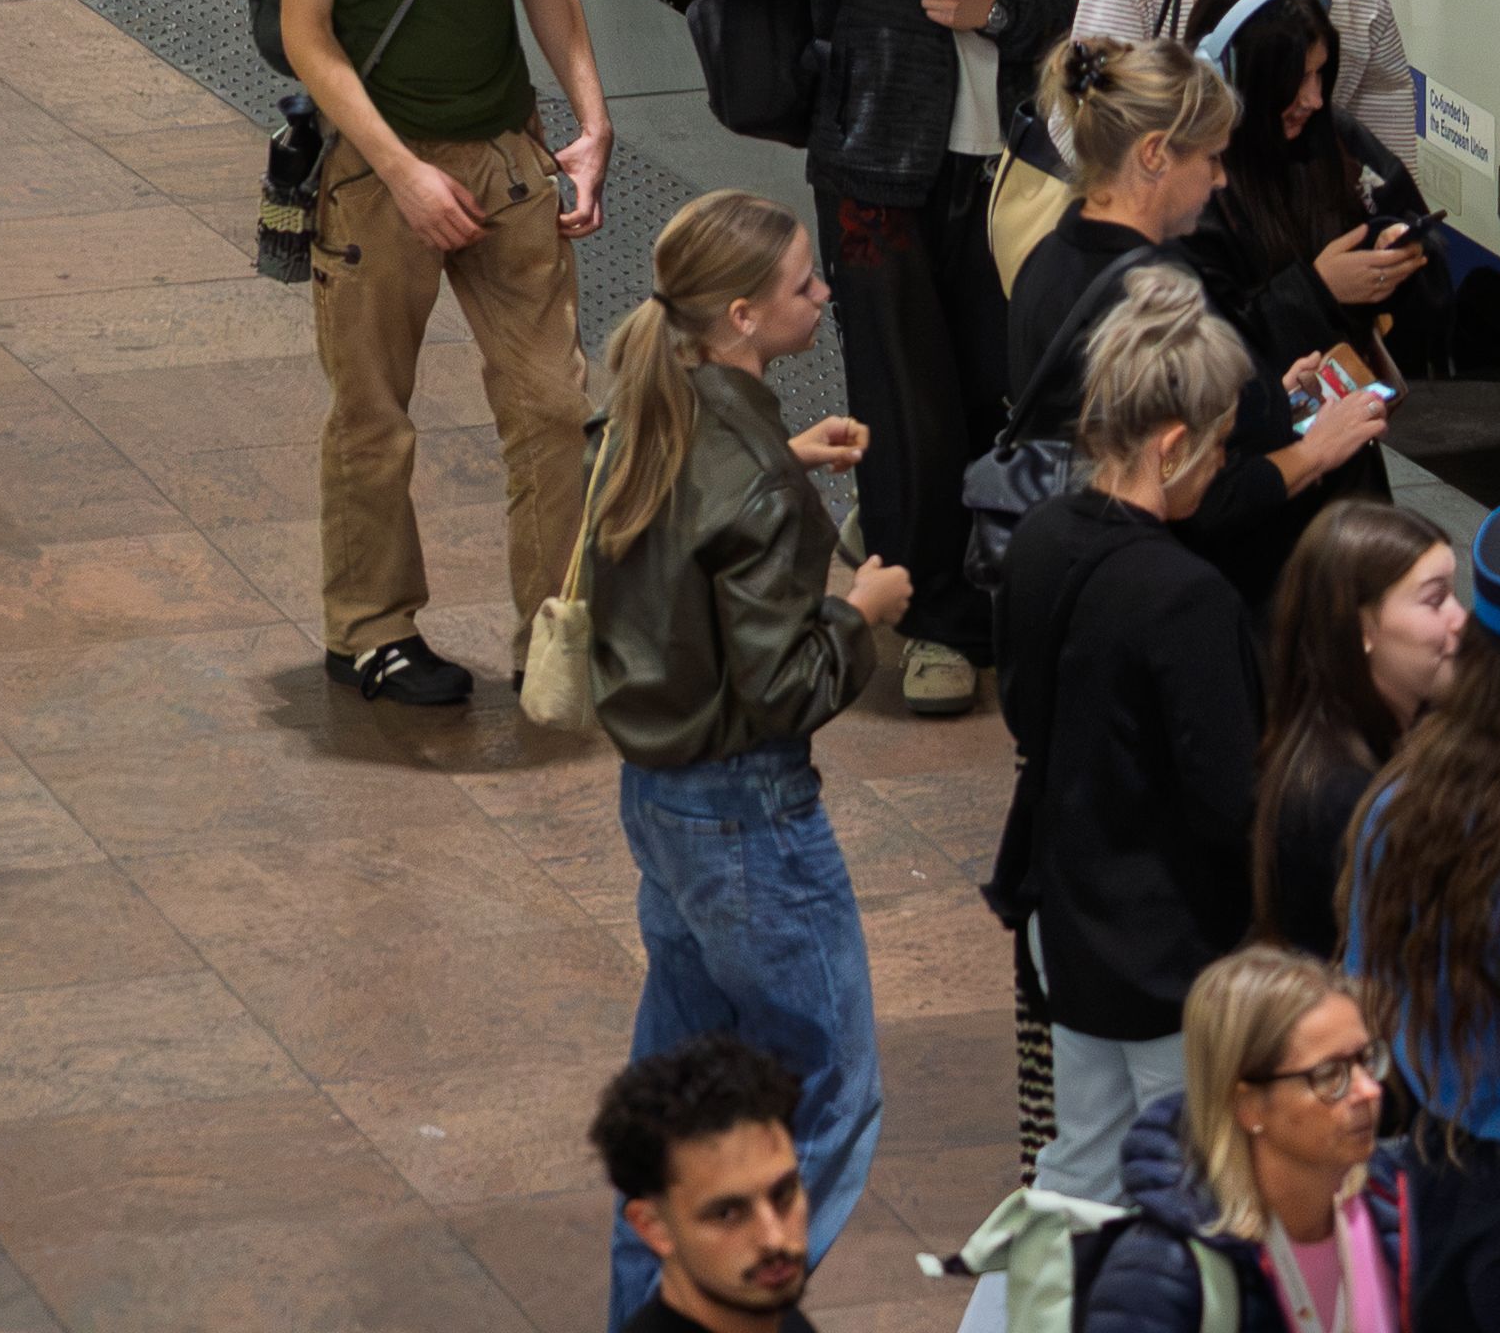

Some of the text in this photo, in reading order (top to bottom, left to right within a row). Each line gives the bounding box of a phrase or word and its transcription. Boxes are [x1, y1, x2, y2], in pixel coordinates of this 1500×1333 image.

[1429, 88, 1470, 132] Co-funded by
[1429, 113, 1489, 163] the European Union
